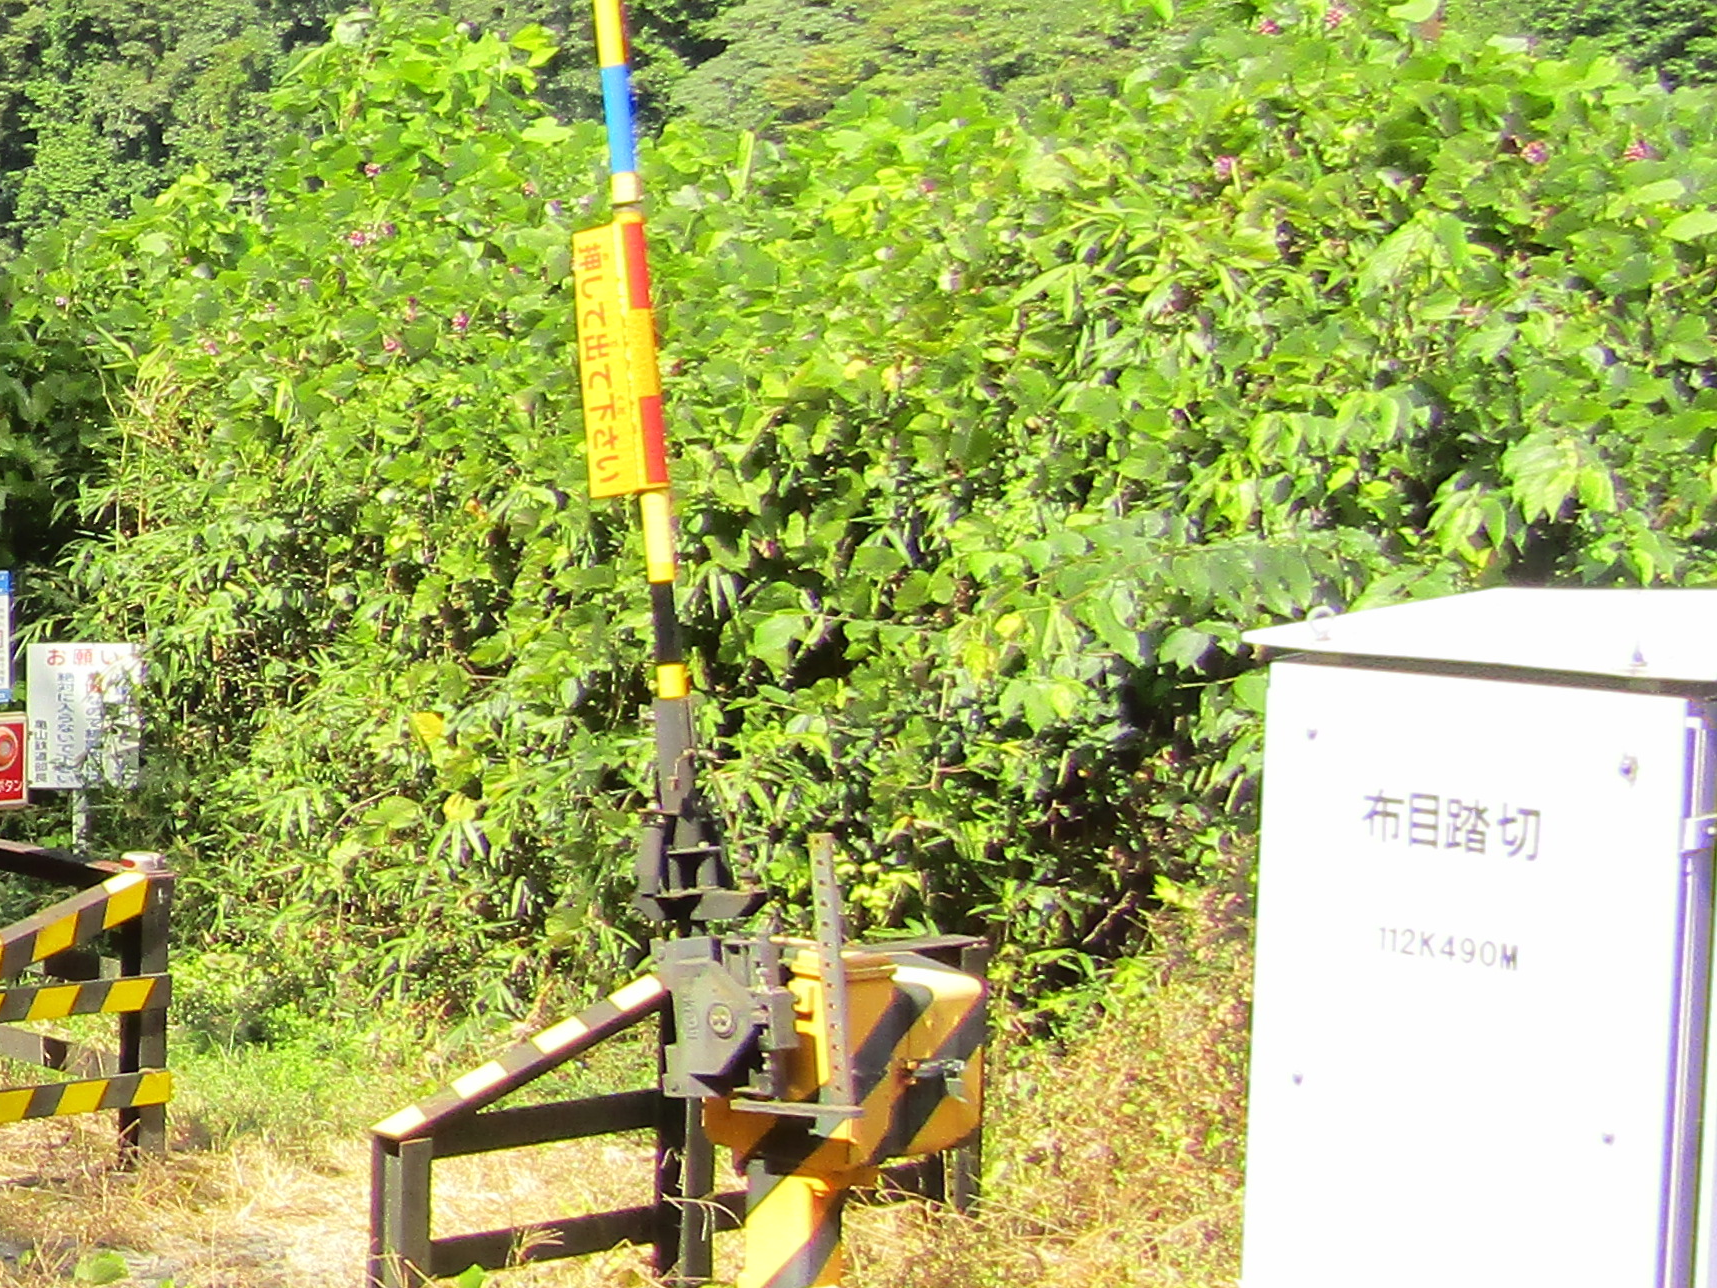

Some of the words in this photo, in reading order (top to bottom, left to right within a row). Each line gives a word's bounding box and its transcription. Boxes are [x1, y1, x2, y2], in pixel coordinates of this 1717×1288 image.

[578, 242, 621, 484] 押して出て下さい
[46, 648, 119, 667] お願い
[1362, 788, 1542, 862] 布目踏切
[1378, 926, 1520, 972] 112K490M
